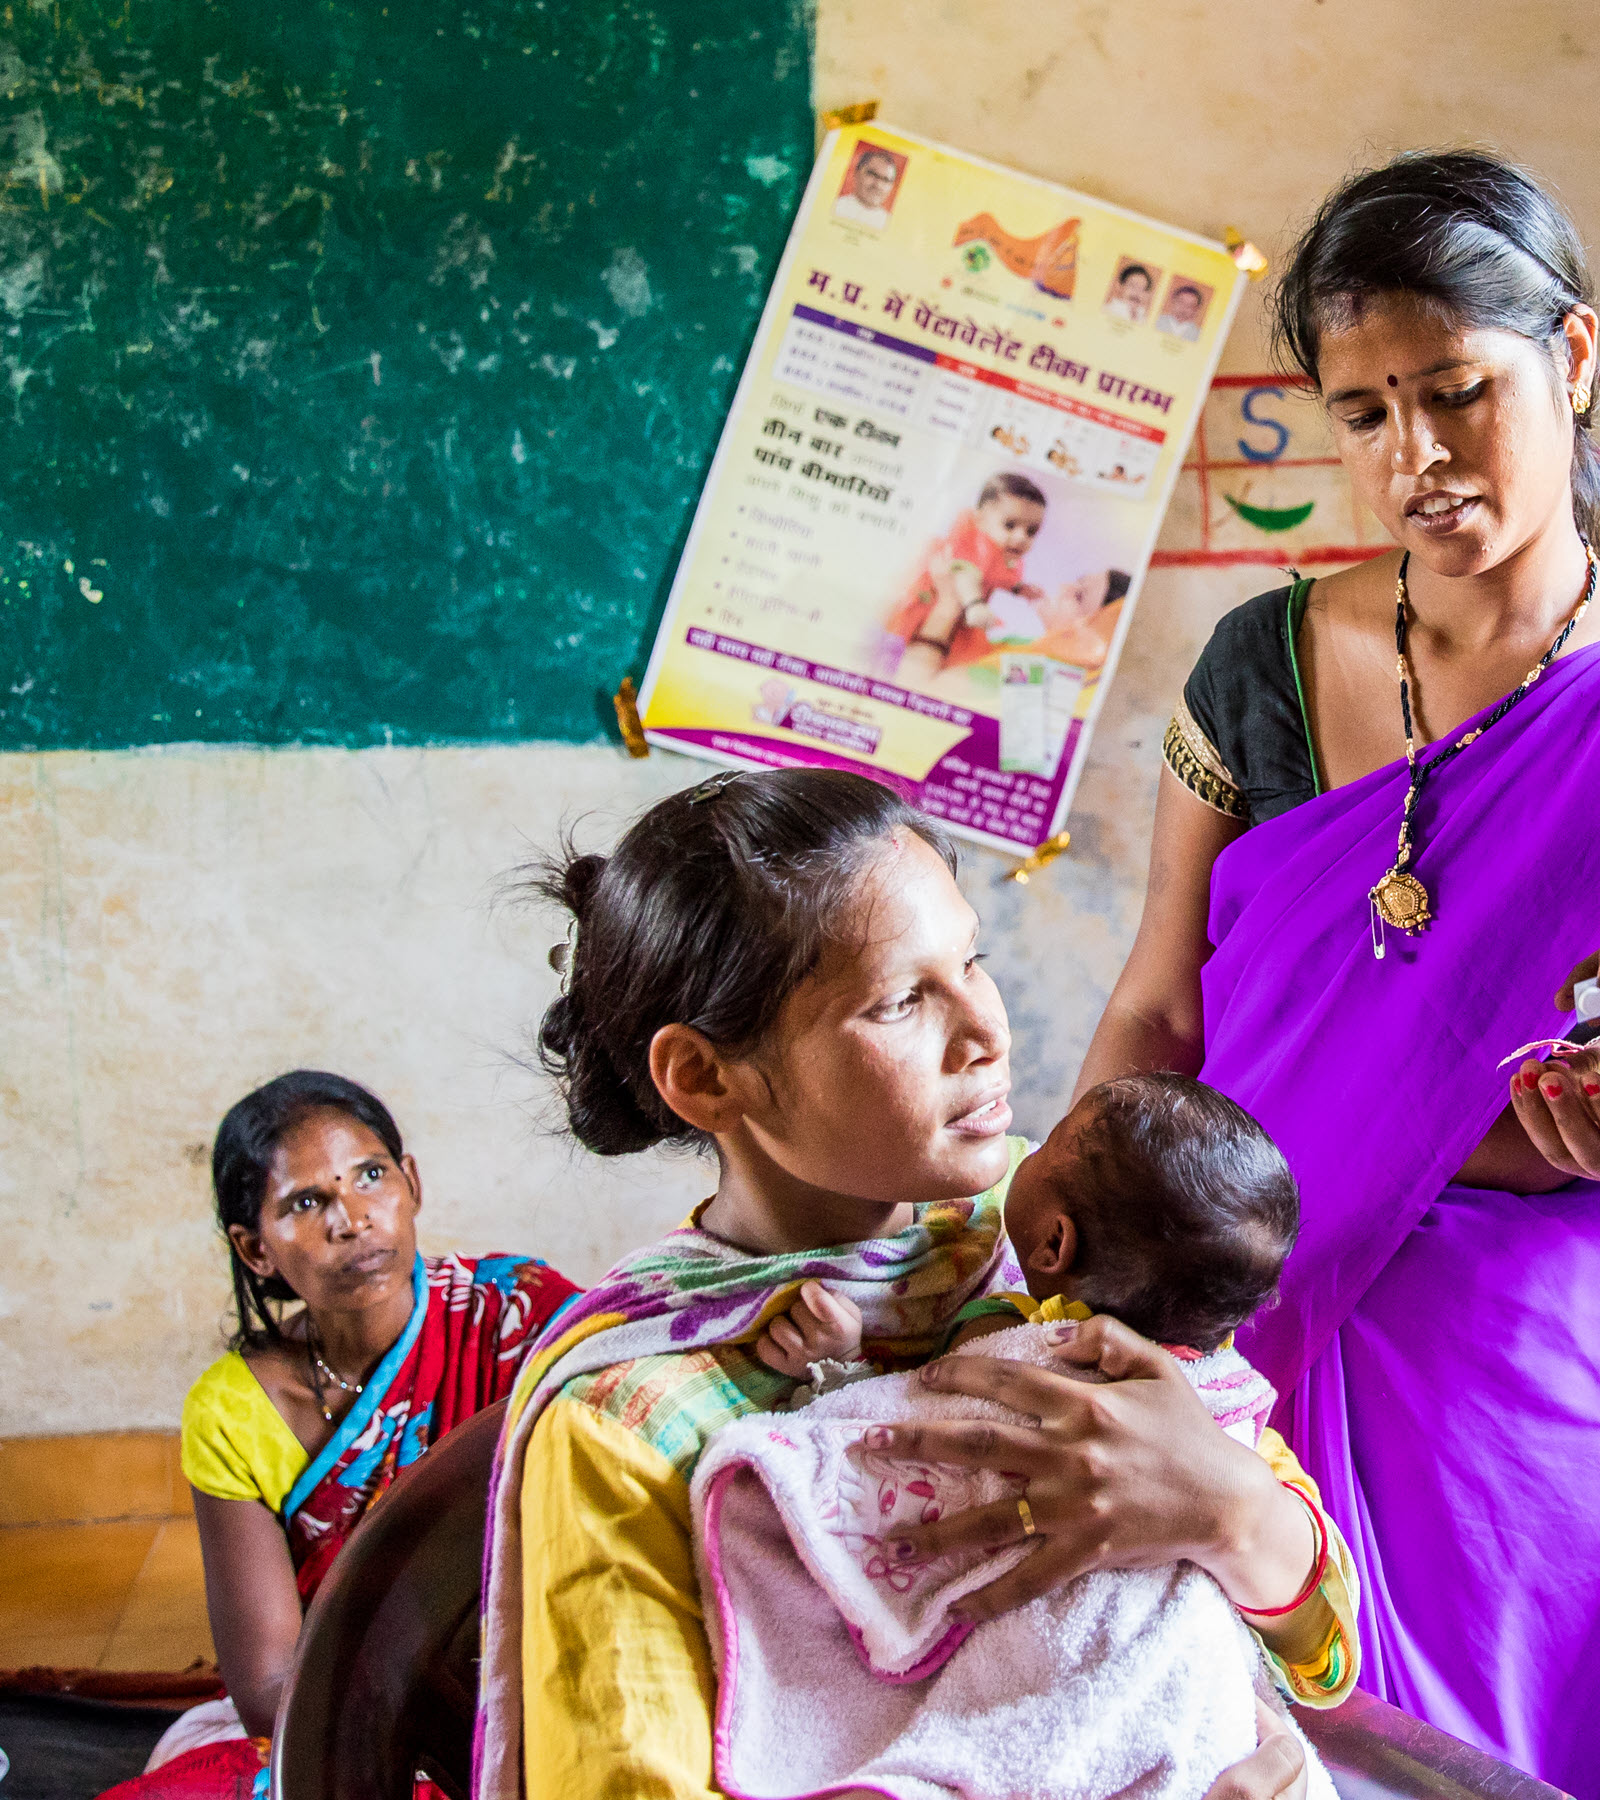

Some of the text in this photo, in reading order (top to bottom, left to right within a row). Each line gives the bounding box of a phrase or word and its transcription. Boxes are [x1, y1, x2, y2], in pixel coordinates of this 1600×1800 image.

[880, 288, 906, 320] में
[1026, 343, 1090, 385] टीका
[762, 416, 802, 445] तीन
[807, 434, 843, 458] बार
[1238, 386, 1289, 464] S
